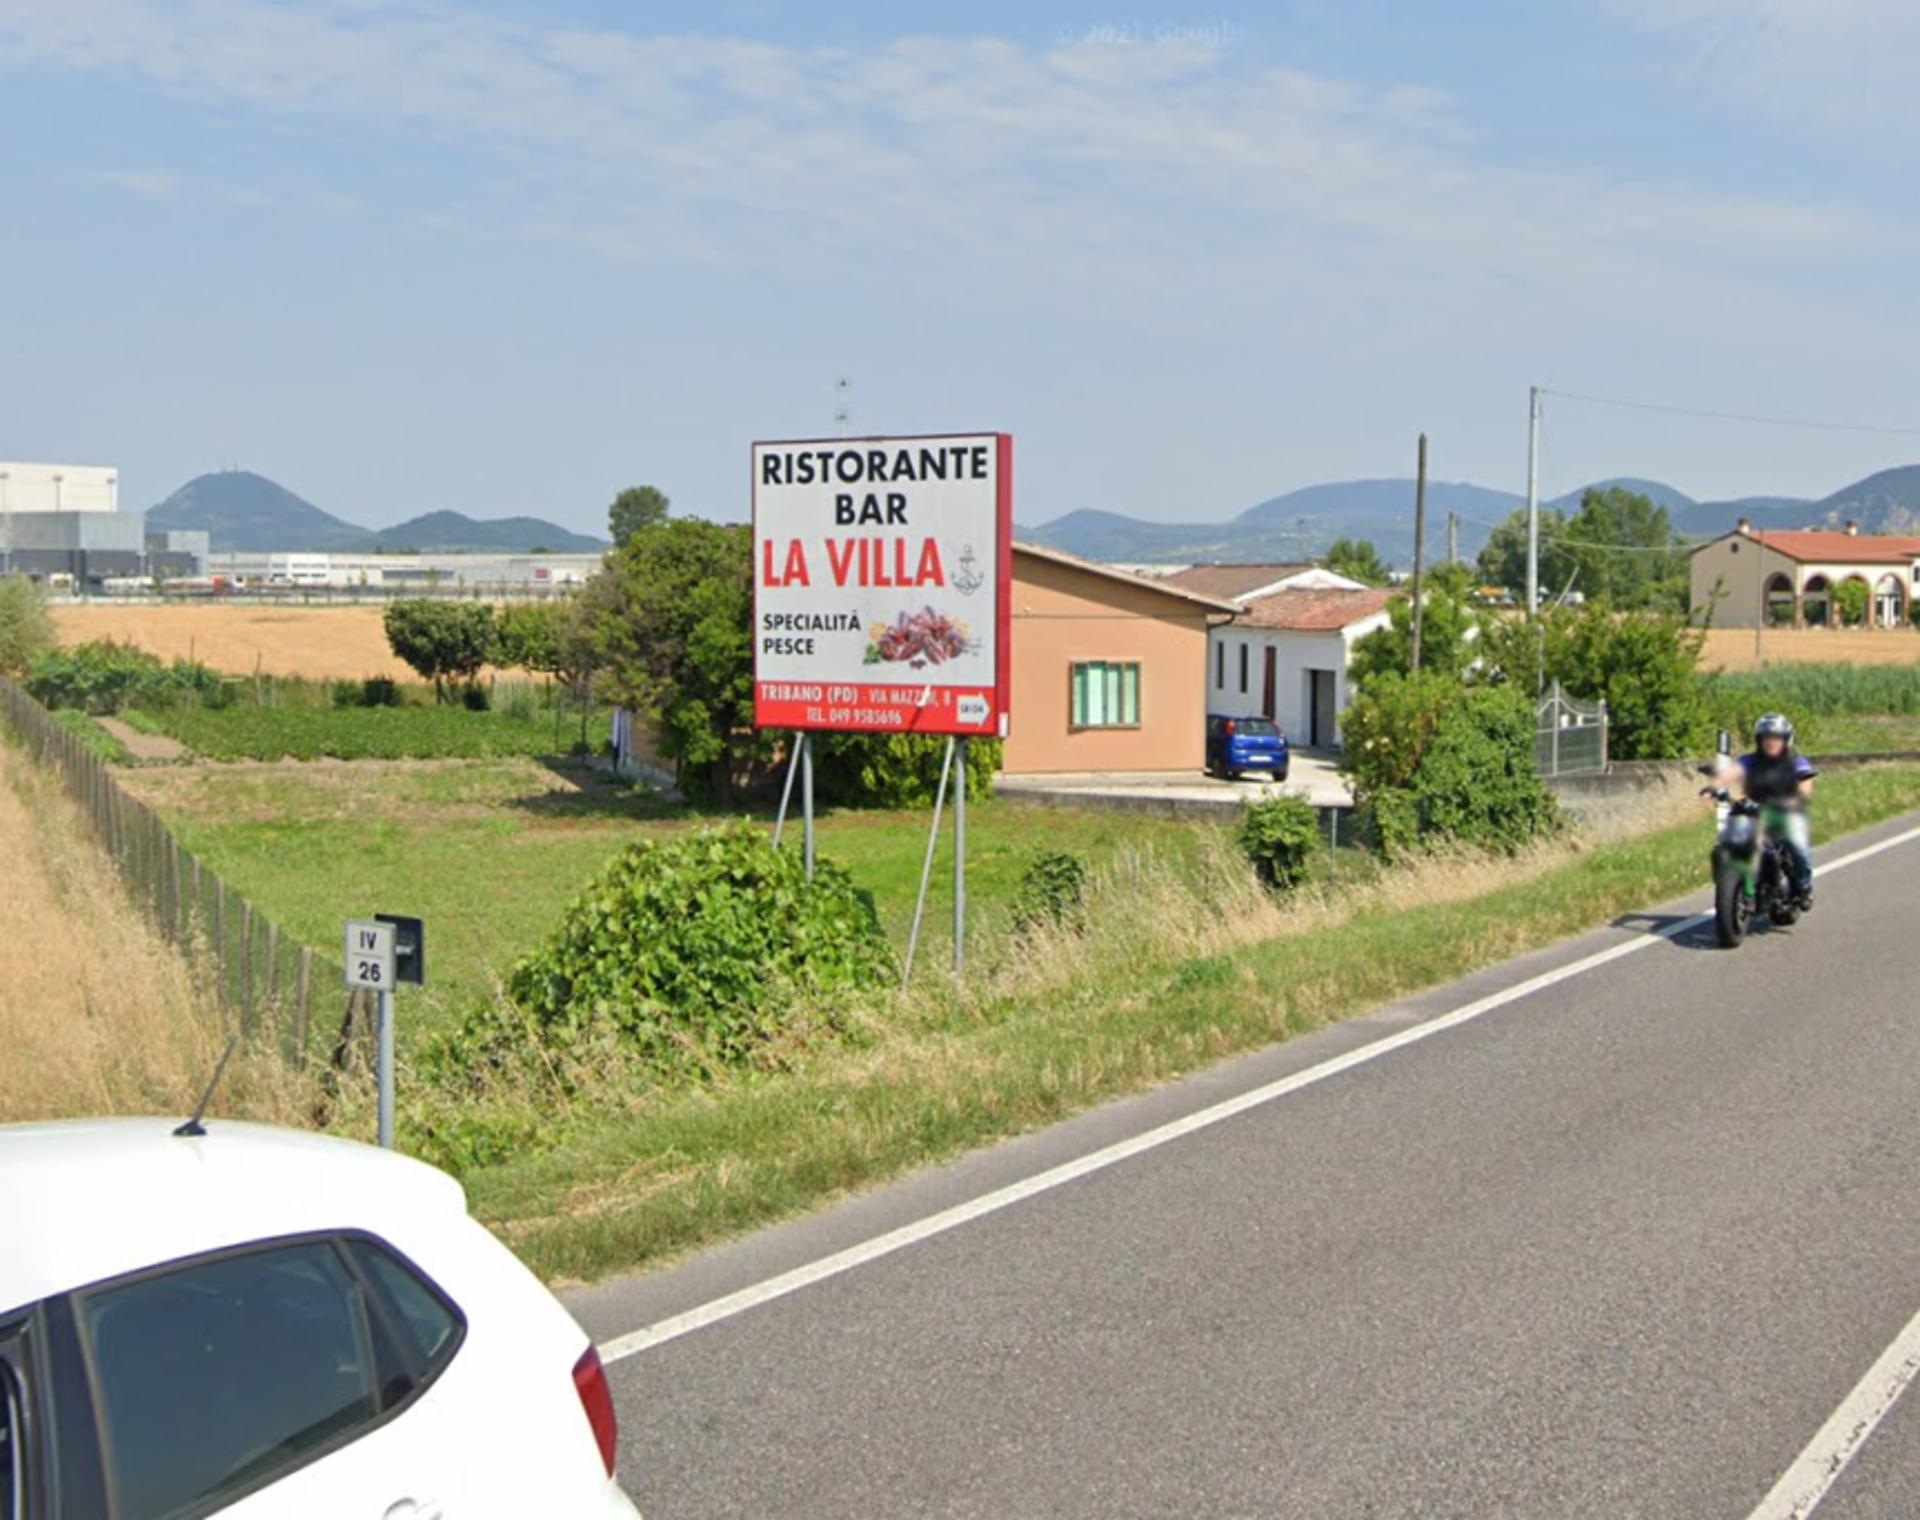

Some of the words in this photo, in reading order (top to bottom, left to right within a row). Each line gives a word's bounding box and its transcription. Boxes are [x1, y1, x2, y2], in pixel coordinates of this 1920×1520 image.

[762, 446, 988, 485] RISTORANTE
[835, 493, 908, 525] BAR
[762, 539, 811, 587] LA
[825, 537, 945, 587] VILLA
[762, 609, 862, 631] SPECIALITÀ
[762, 638, 815, 655] PESCE
[761, 684, 822, 702] TRIBANO
[360, 931, 377, 950] IV
[358, 961, 381, 982] 26
